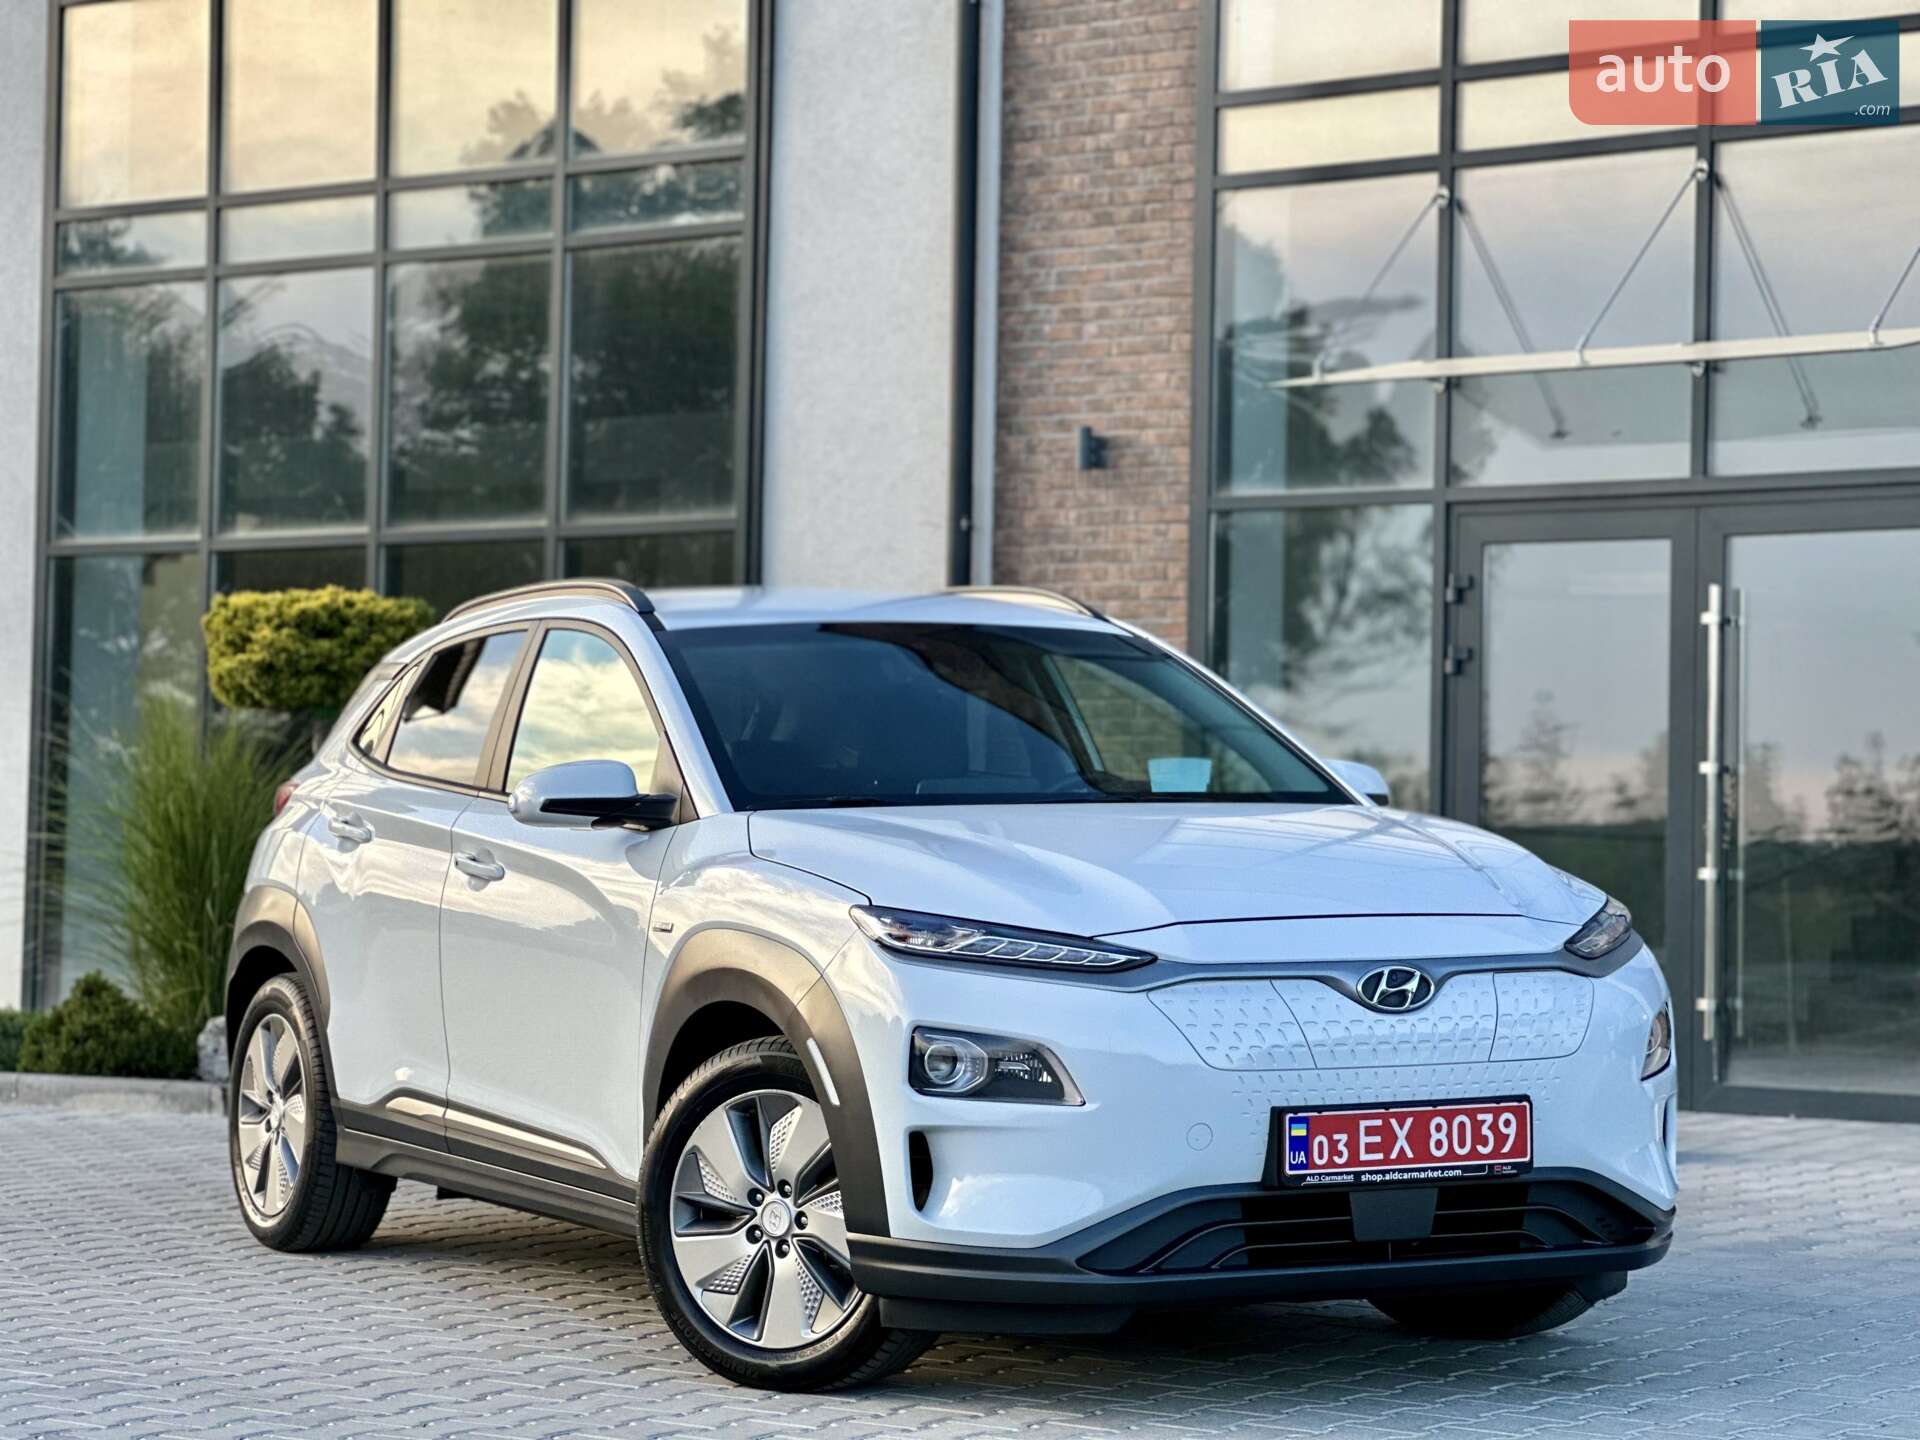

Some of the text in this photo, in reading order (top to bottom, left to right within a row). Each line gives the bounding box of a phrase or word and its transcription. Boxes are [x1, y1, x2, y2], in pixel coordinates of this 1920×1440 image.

[1312, 1112, 1517, 1166] 03 EX 8039
[1290, 1151, 1306, 1165] UA
[1320, 1173, 1354, 1182] Carmarket
[1361, 1168, 1462, 1182] shop.aldcarmarket.com
